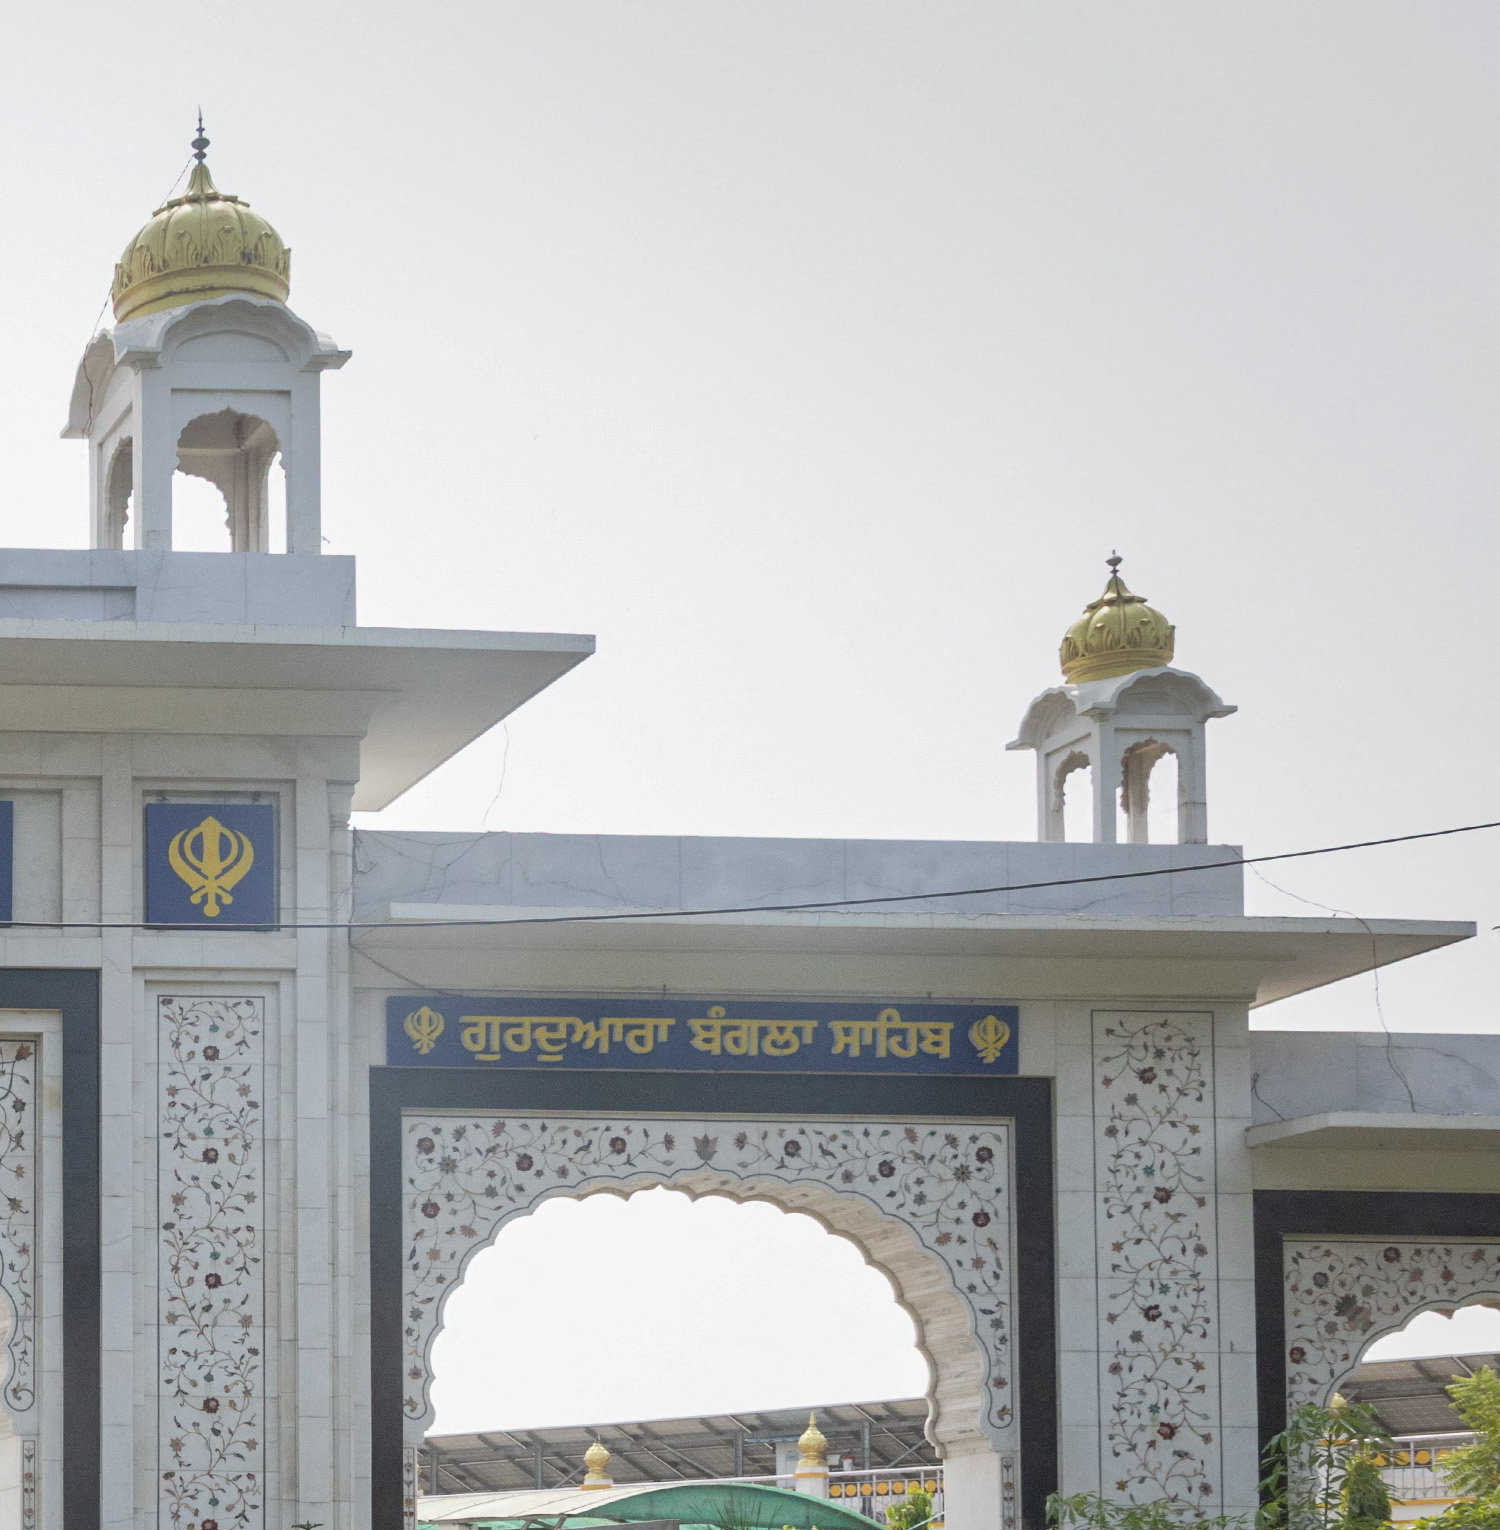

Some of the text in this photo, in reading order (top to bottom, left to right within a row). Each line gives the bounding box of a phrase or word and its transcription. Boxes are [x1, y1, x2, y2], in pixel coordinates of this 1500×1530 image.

[460, 1006, 953, 1062] ਗੁਰਦੁਆਰਾ ਬੰਗਲਾ ਸਾਹਿਬ
